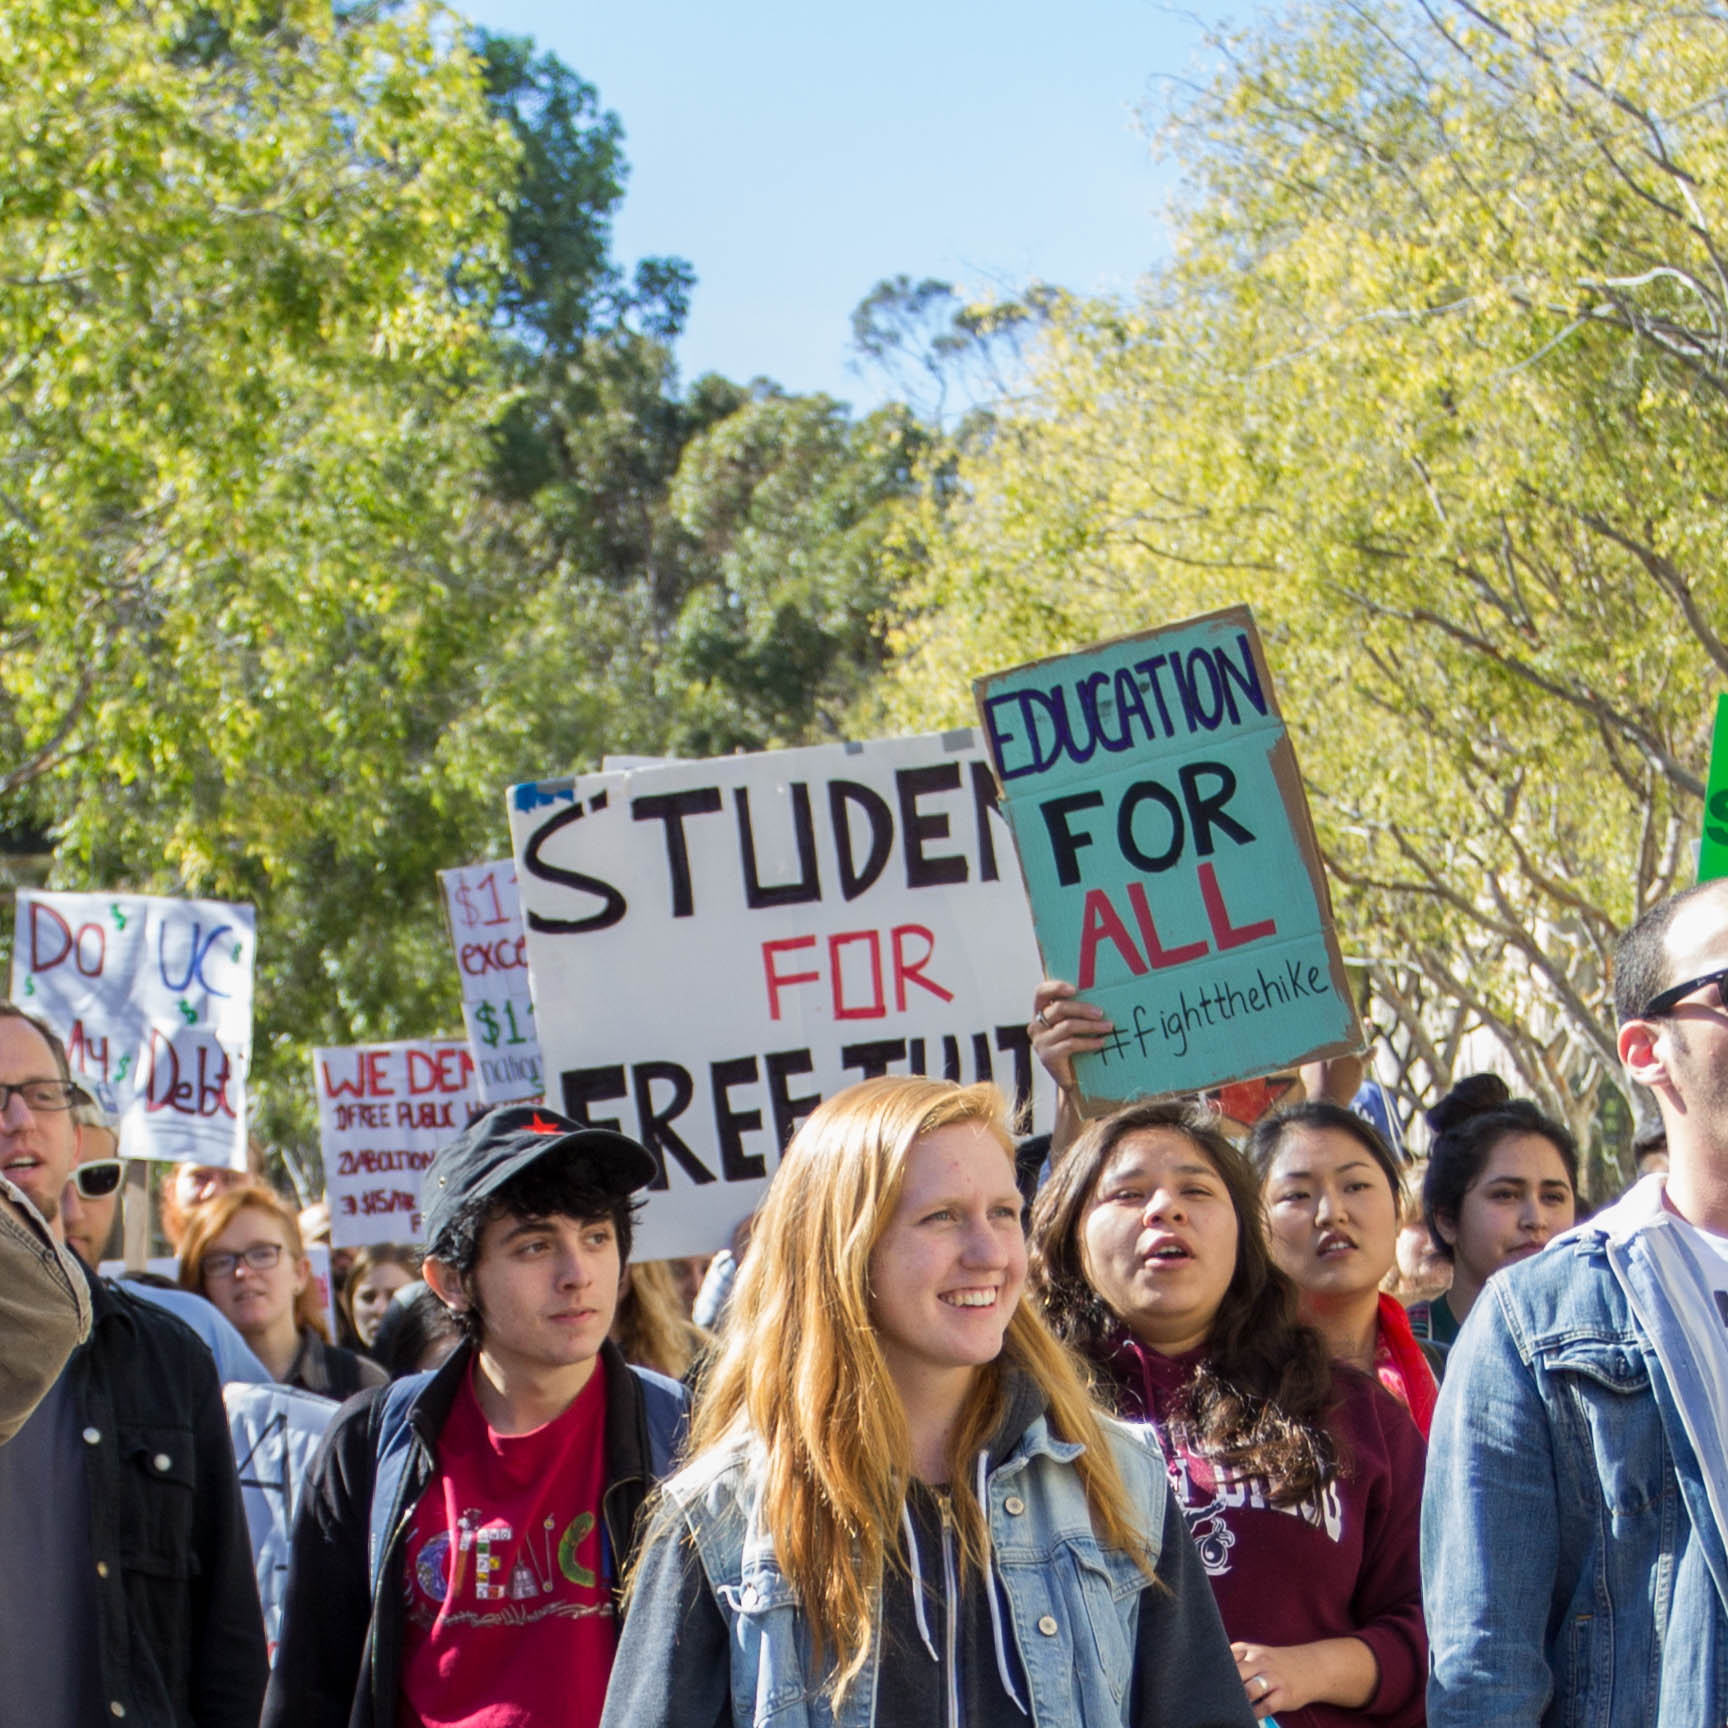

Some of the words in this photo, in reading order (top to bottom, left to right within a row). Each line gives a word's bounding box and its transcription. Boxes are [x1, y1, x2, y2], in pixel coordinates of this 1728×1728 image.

[983, 633, 1270, 782] EDUCATION
[1039, 761, 1256, 886] FOR
[762, 924, 953, 1021] FOR
[1078, 863, 1275, 990] ALL
[147, 1029, 237, 1118] Debt
[323, 1050, 395, 1098] WE
[397, 1101, 456, 1129] PUBLIC
[562, 1048, 822, 1191] FREE
